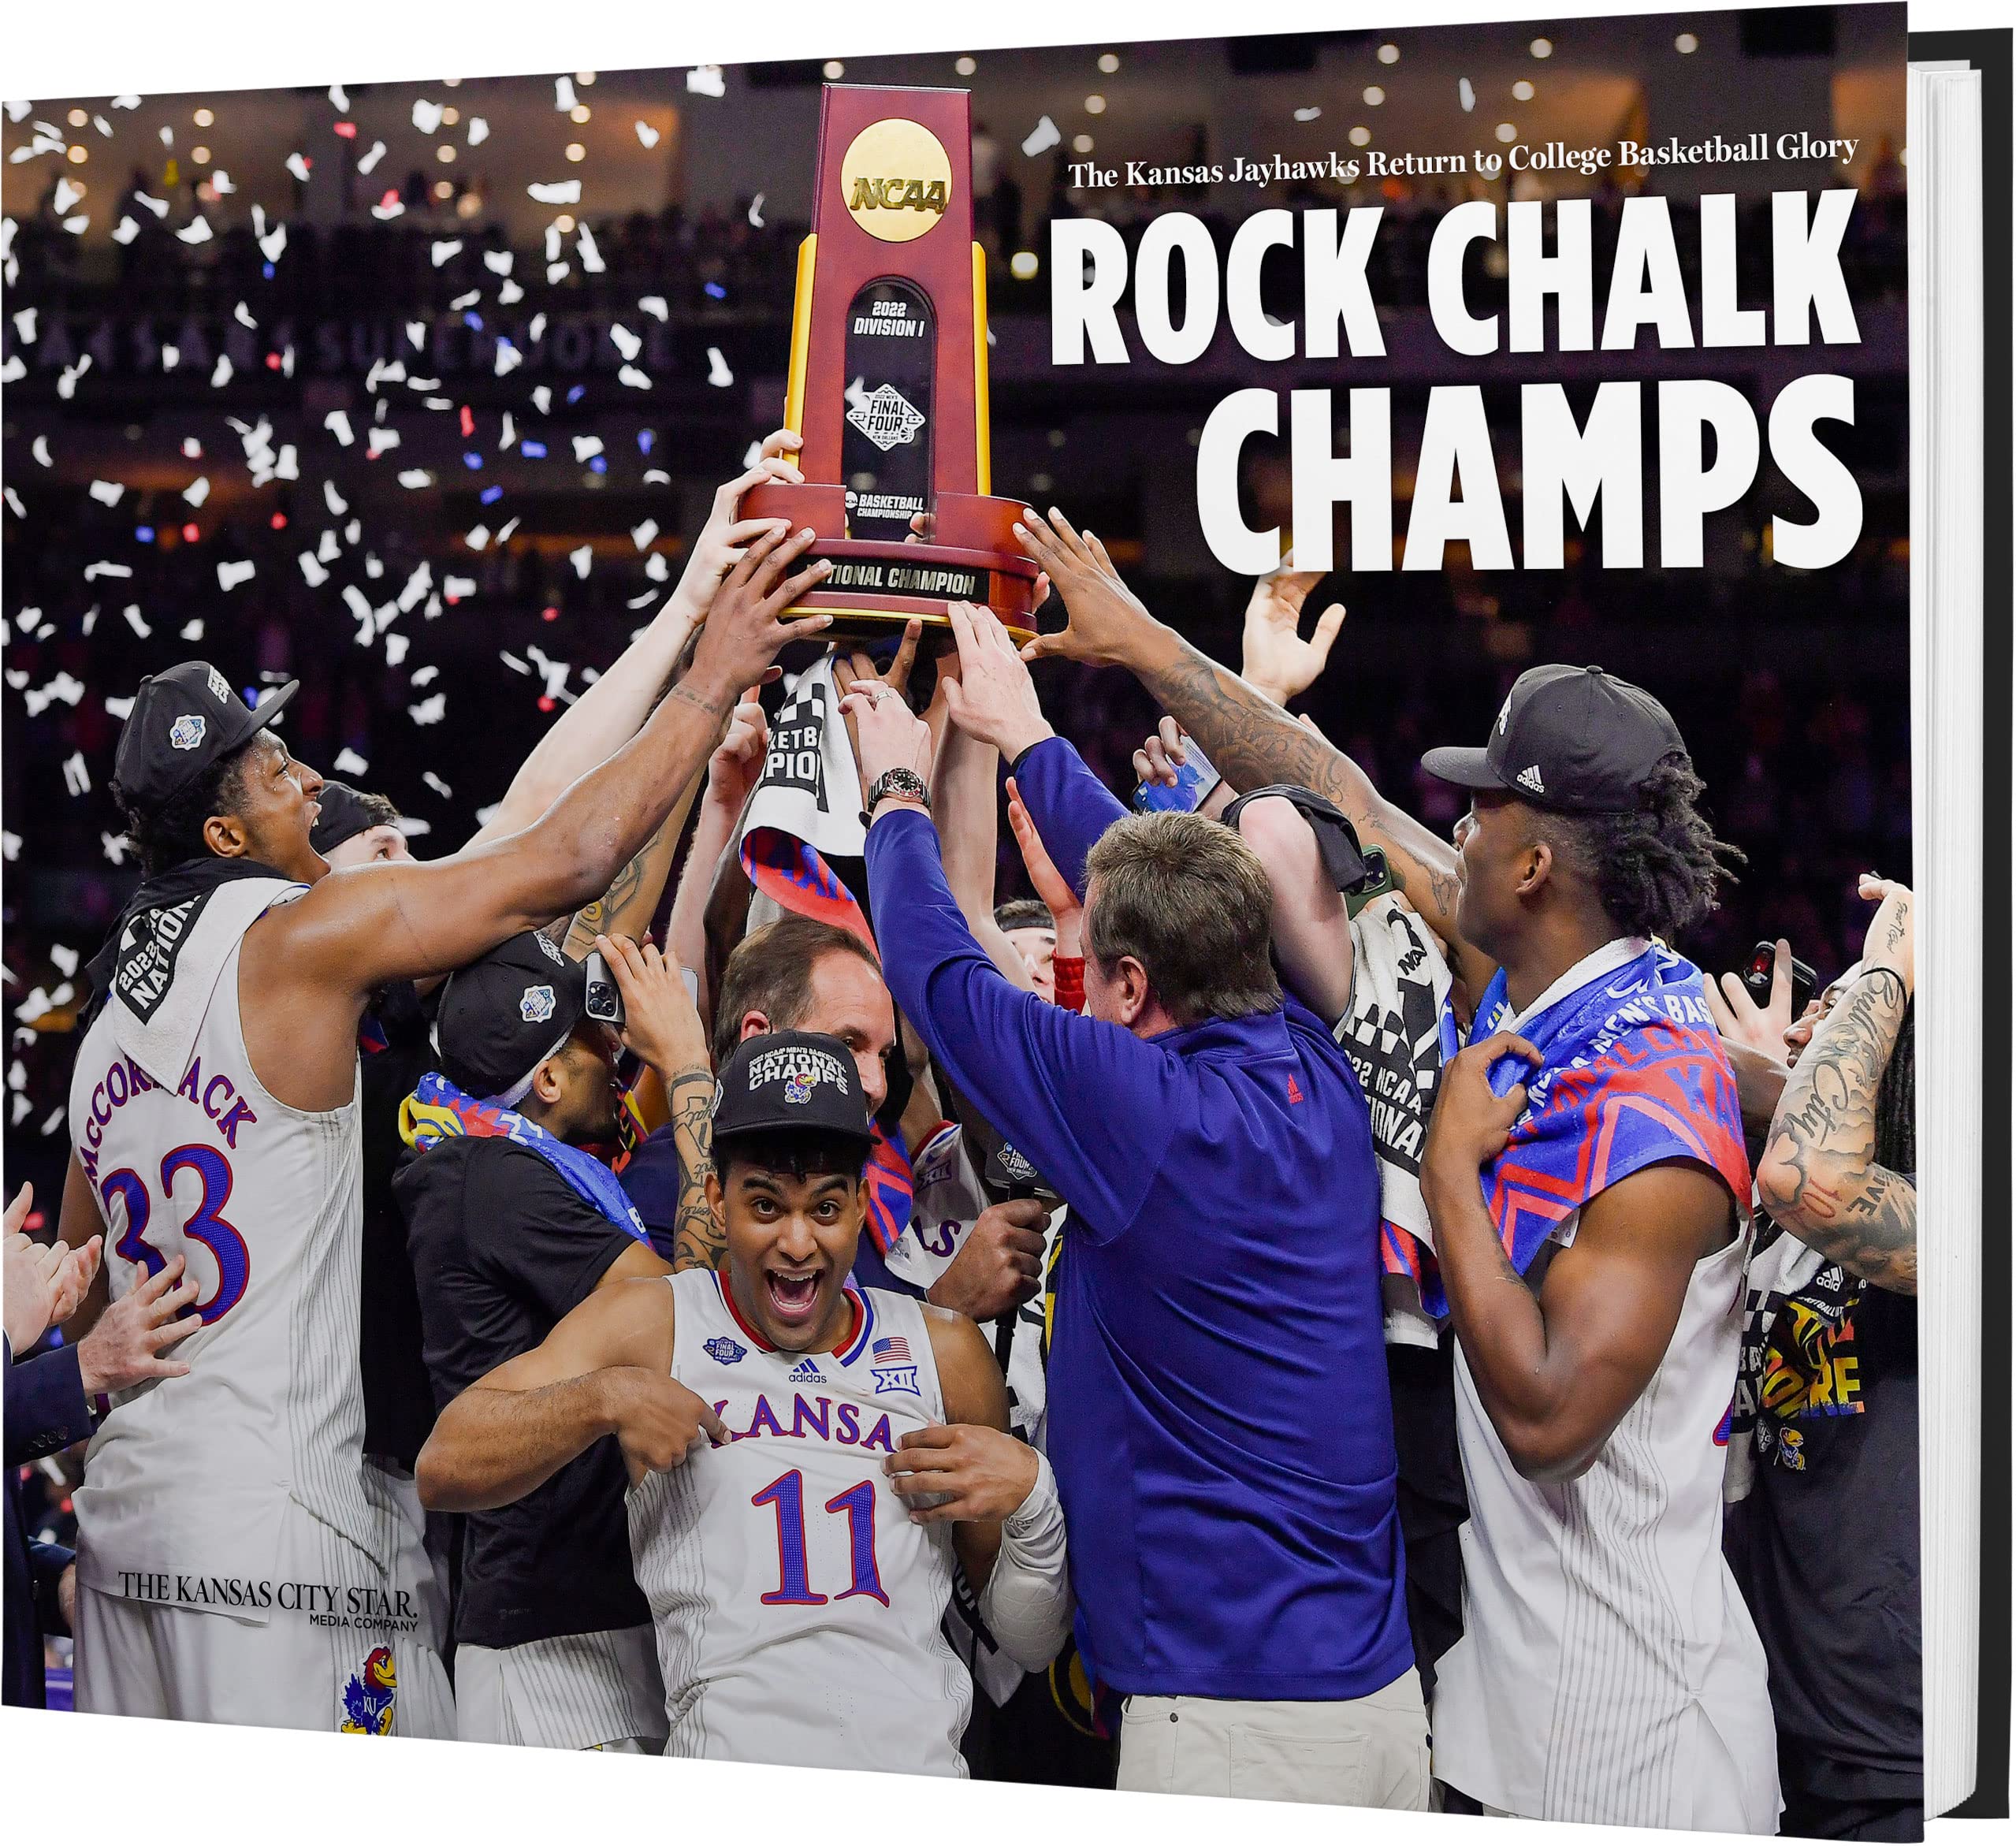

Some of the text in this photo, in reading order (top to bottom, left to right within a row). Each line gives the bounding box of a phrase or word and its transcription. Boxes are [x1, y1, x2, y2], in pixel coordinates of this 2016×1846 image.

[1068, 132, 1859, 188] The Kansas Jayhawks Return to College Basketball Glory
[850, 177, 947, 214] NCAA
[1051, 188, 1862, 365] ROCK CHALK
[872, 301, 906, 317] 2022
[854, 318, 925, 337] DIVISION I
[867, 415, 903, 432] FOUR
[870, 400, 905, 415] FINAL
[1196, 374, 1864, 575] CHAMPS
[857, 508, 913, 519] CHAMPIONSHIP
[858, 494, 924, 511] BASKETBALL
[809, 564, 976, 596] TIONAL CHAMPION
[1516, 773, 1545, 795] adidas
[119, 940, 157, 992] 2022
[1588, 996, 1665, 1055] MEN'S
[749, 1053, 845, 1078] NATIONAL
[749, 1064, 849, 1096] CHAMPS
[1377, 1068, 1423, 1116] NCAA
[80, 1055, 258, 1191] McCORACK
[100, 1144, 251, 1327] 33
[1816, 1275, 1842, 1293] adid
[788, 1371, 828, 1384] adidas
[751, 1468, 891, 1609] 11
[118, 1570, 418, 1619] THE KANSAS CITY STAR.
[309, 1613, 418, 1633] MEDIA COMPANY
[363, 1695, 377, 1717] KU
